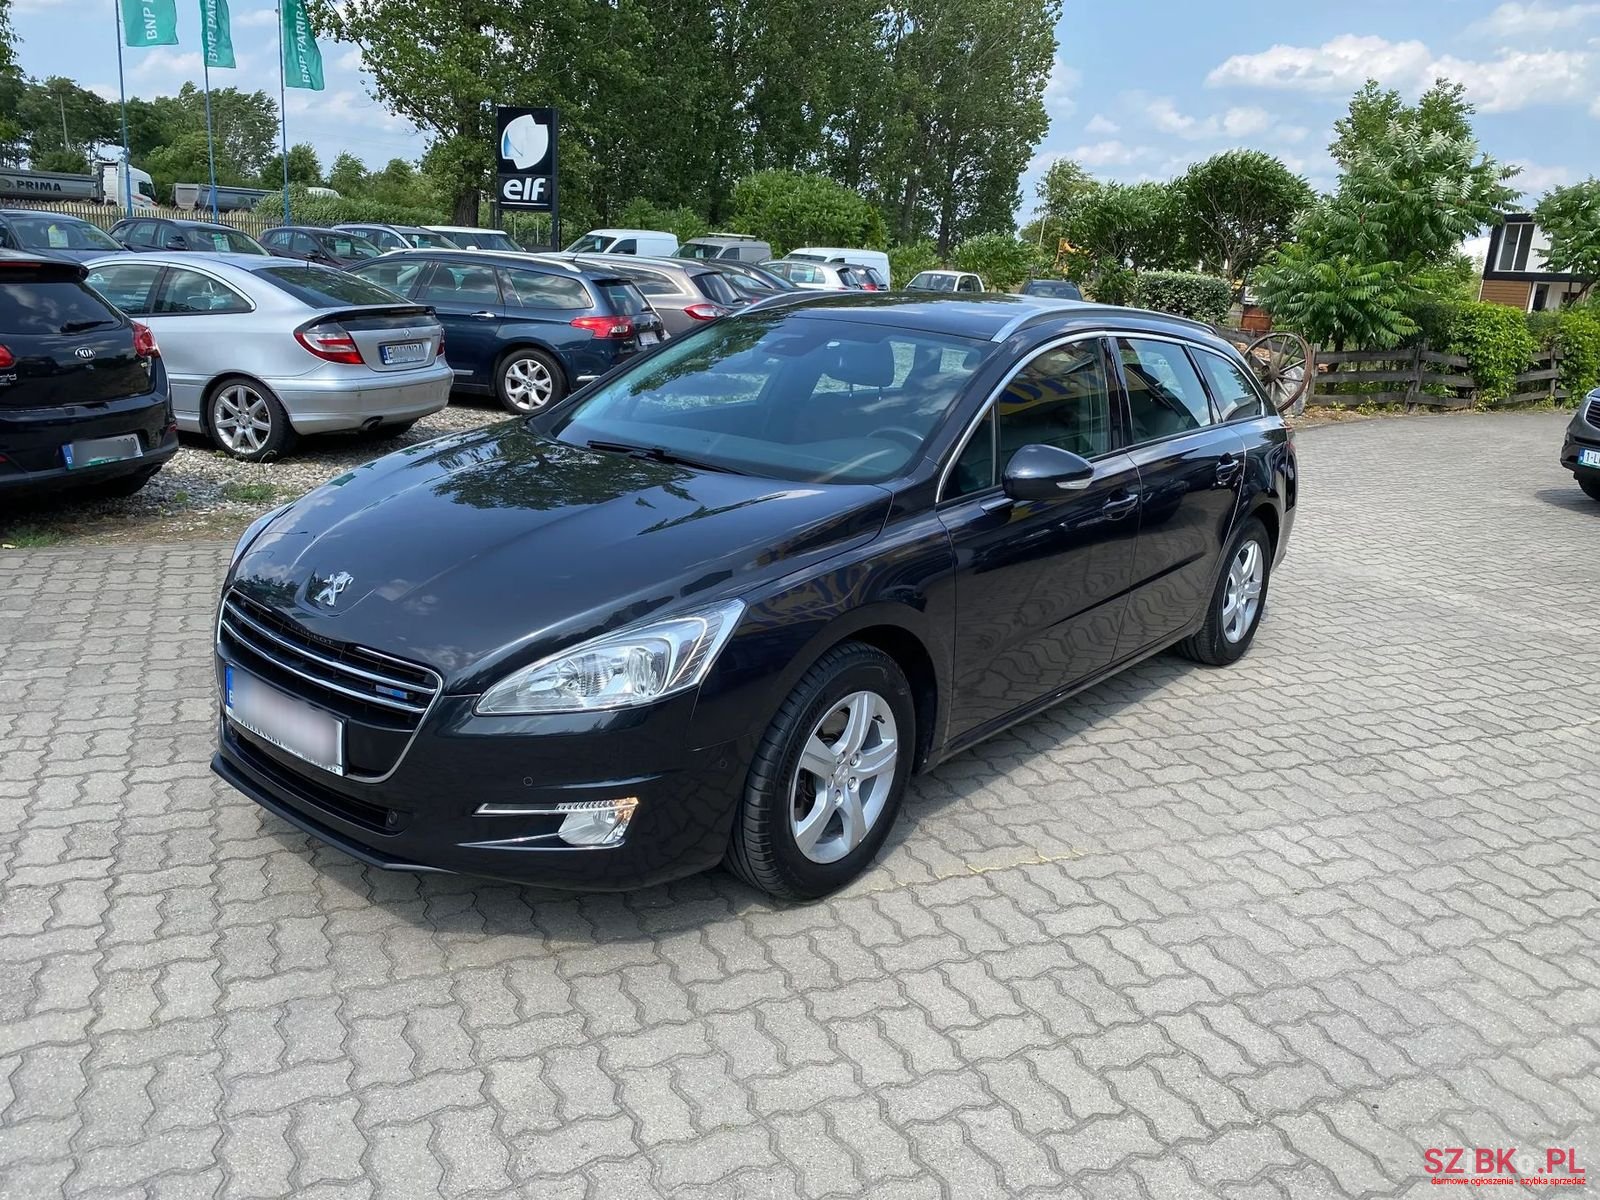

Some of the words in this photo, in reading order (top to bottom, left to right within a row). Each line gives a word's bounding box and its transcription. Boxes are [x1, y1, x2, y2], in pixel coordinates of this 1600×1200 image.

[143, 7, 157, 40] BNP
[208, 31, 218, 62] BNP
[299, 56, 311, 83] BNP
[16, 180, 62, 192] PRIMA
[503, 177, 546, 200] elf
[79, 349, 94, 358] KIA
